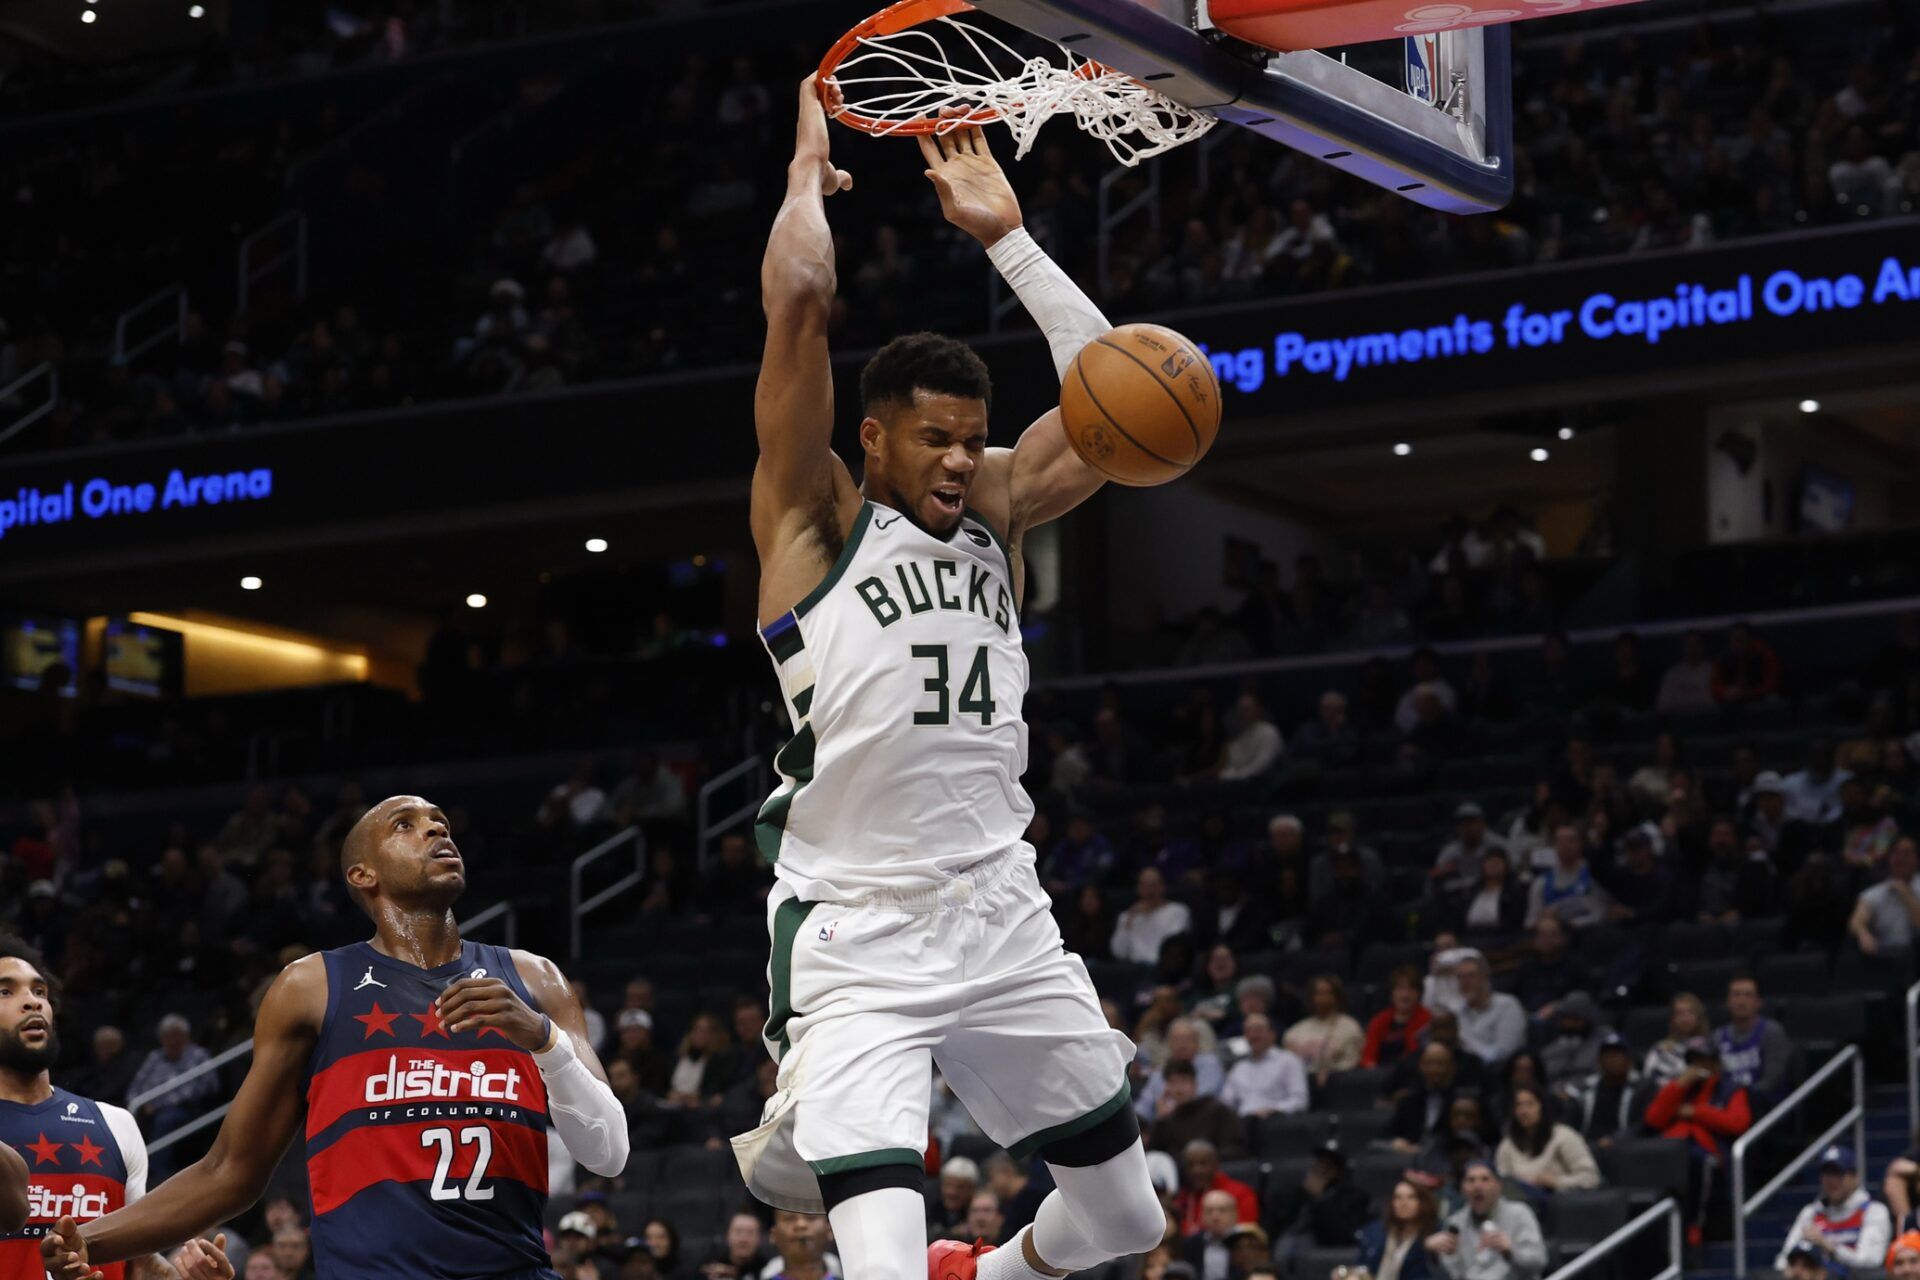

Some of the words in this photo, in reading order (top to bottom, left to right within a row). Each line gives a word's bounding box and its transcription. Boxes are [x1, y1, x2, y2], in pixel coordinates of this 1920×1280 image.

[1410, 64, 1427, 92] NBA
[1198, 343, 1265, 393] ng
[1274, 314, 1495, 381] Payments
[1502, 303, 1574, 348] for
[1578, 274, 1753, 344] Capital
[1762, 269, 1866, 317] One
[81, 477, 157, 519] One
[161, 468, 273, 510] Arena
[854, 559, 1011, 636] BUCKS
[910, 643, 997, 727] 34
[365, 1053, 521, 1103] district
[408, 1059, 435, 1070] THE
[369, 1111, 391, 1121] OF
[420, 1126, 496, 1202] 22
[27, 1183, 109, 1219] strict
